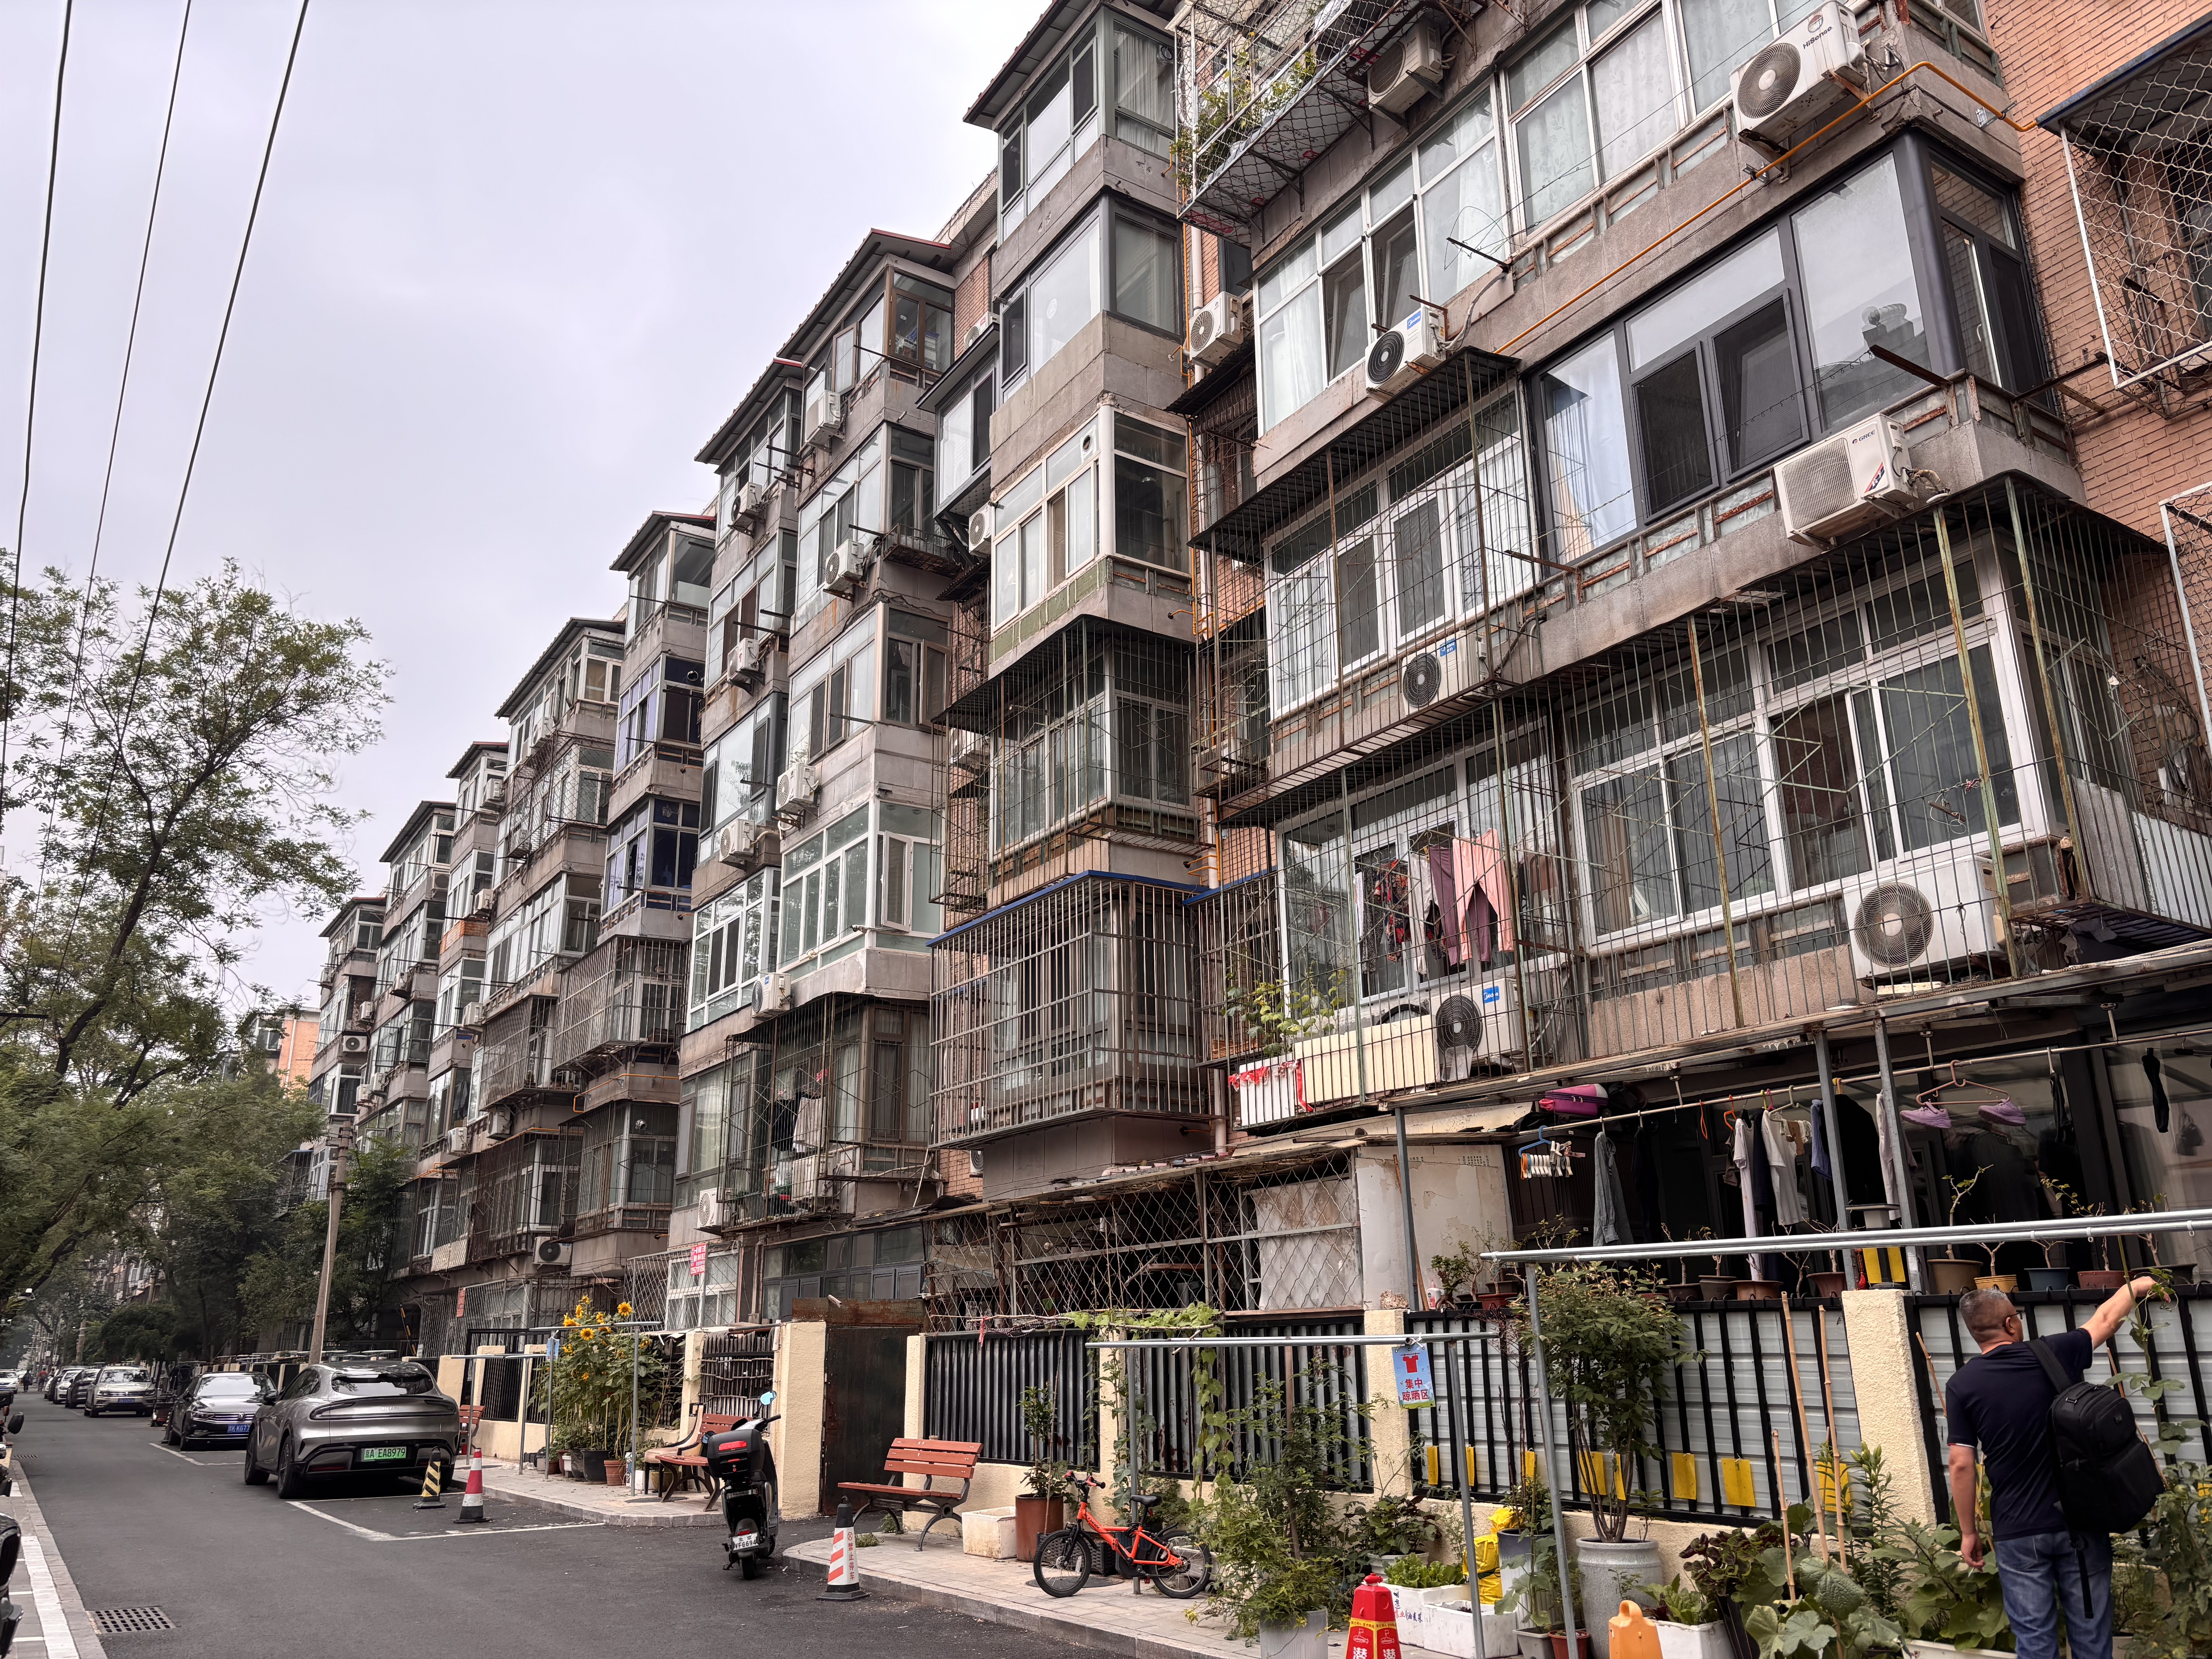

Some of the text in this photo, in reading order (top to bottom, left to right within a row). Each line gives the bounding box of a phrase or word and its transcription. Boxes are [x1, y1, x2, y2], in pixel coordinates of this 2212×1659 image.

[1859, 430, 1875, 441] GREE
[1405, 1377, 1423, 1389] 集中
[1402, 1389, 1430, 1401] 晾晒区
[365, 1448, 405, 1458] 京A EA8979
